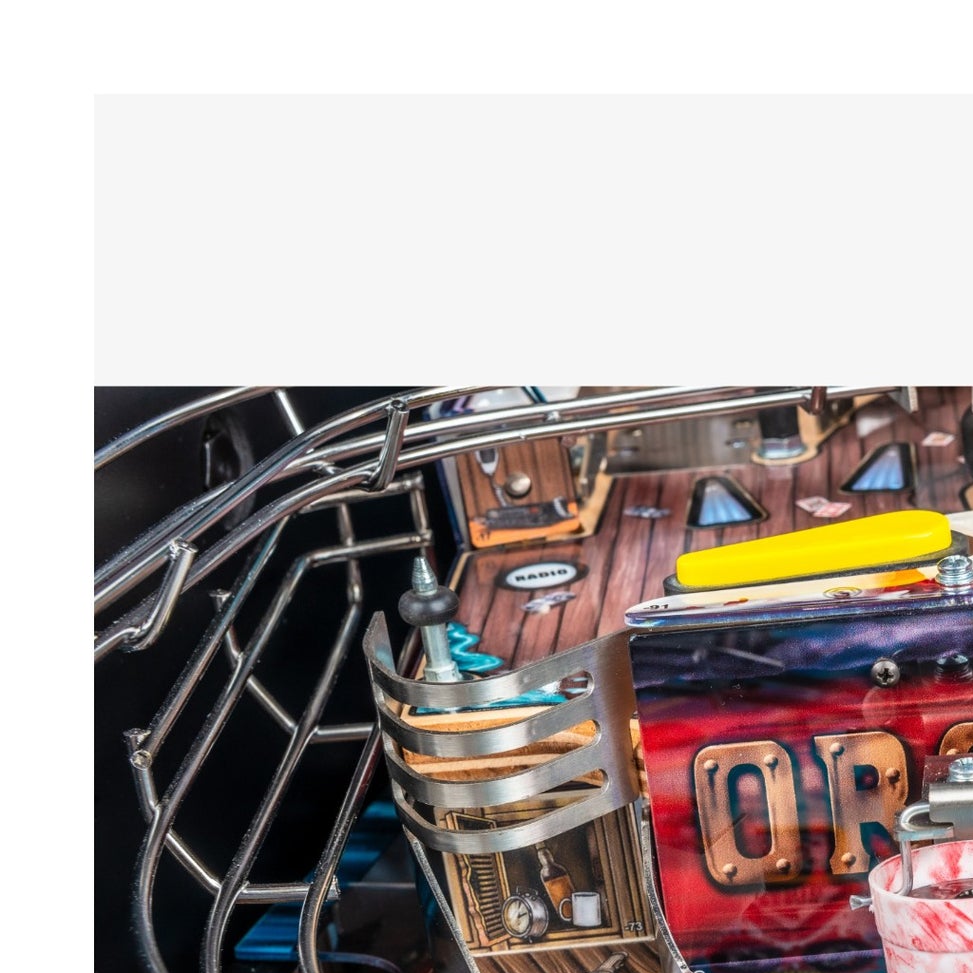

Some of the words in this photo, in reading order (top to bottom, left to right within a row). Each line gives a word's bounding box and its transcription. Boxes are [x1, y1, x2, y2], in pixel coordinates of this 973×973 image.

[515, 568, 569, 583] RADIO
[643, 603, 670, 611] -91
[625, 921, 644, 932] -73
